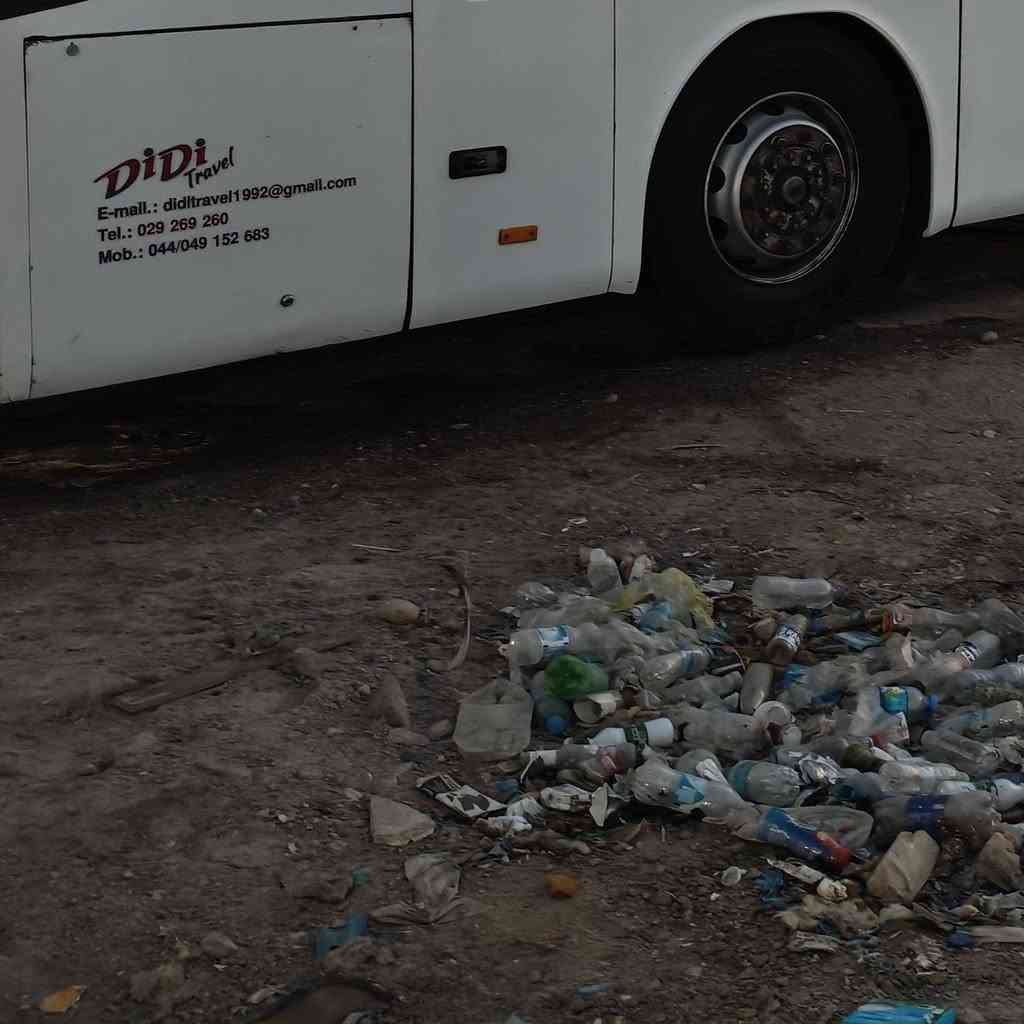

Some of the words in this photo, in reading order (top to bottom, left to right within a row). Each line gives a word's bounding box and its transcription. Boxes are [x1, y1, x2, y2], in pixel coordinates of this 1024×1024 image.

[93, 138, 208, 200] DiDi
[184, 146, 235, 189] Travel
[162, 176, 357, 212] diditravel1992@gmail.com
[98, 226, 132, 242] Tel.:
[137, 221, 165, 237] 029
[170, 217, 197, 233] 269
[202, 212, 229, 228] 260
[98, 247, 144, 264] Mob.:
[148, 236, 208, 257] 044/049
[213, 231, 239, 248] 152
